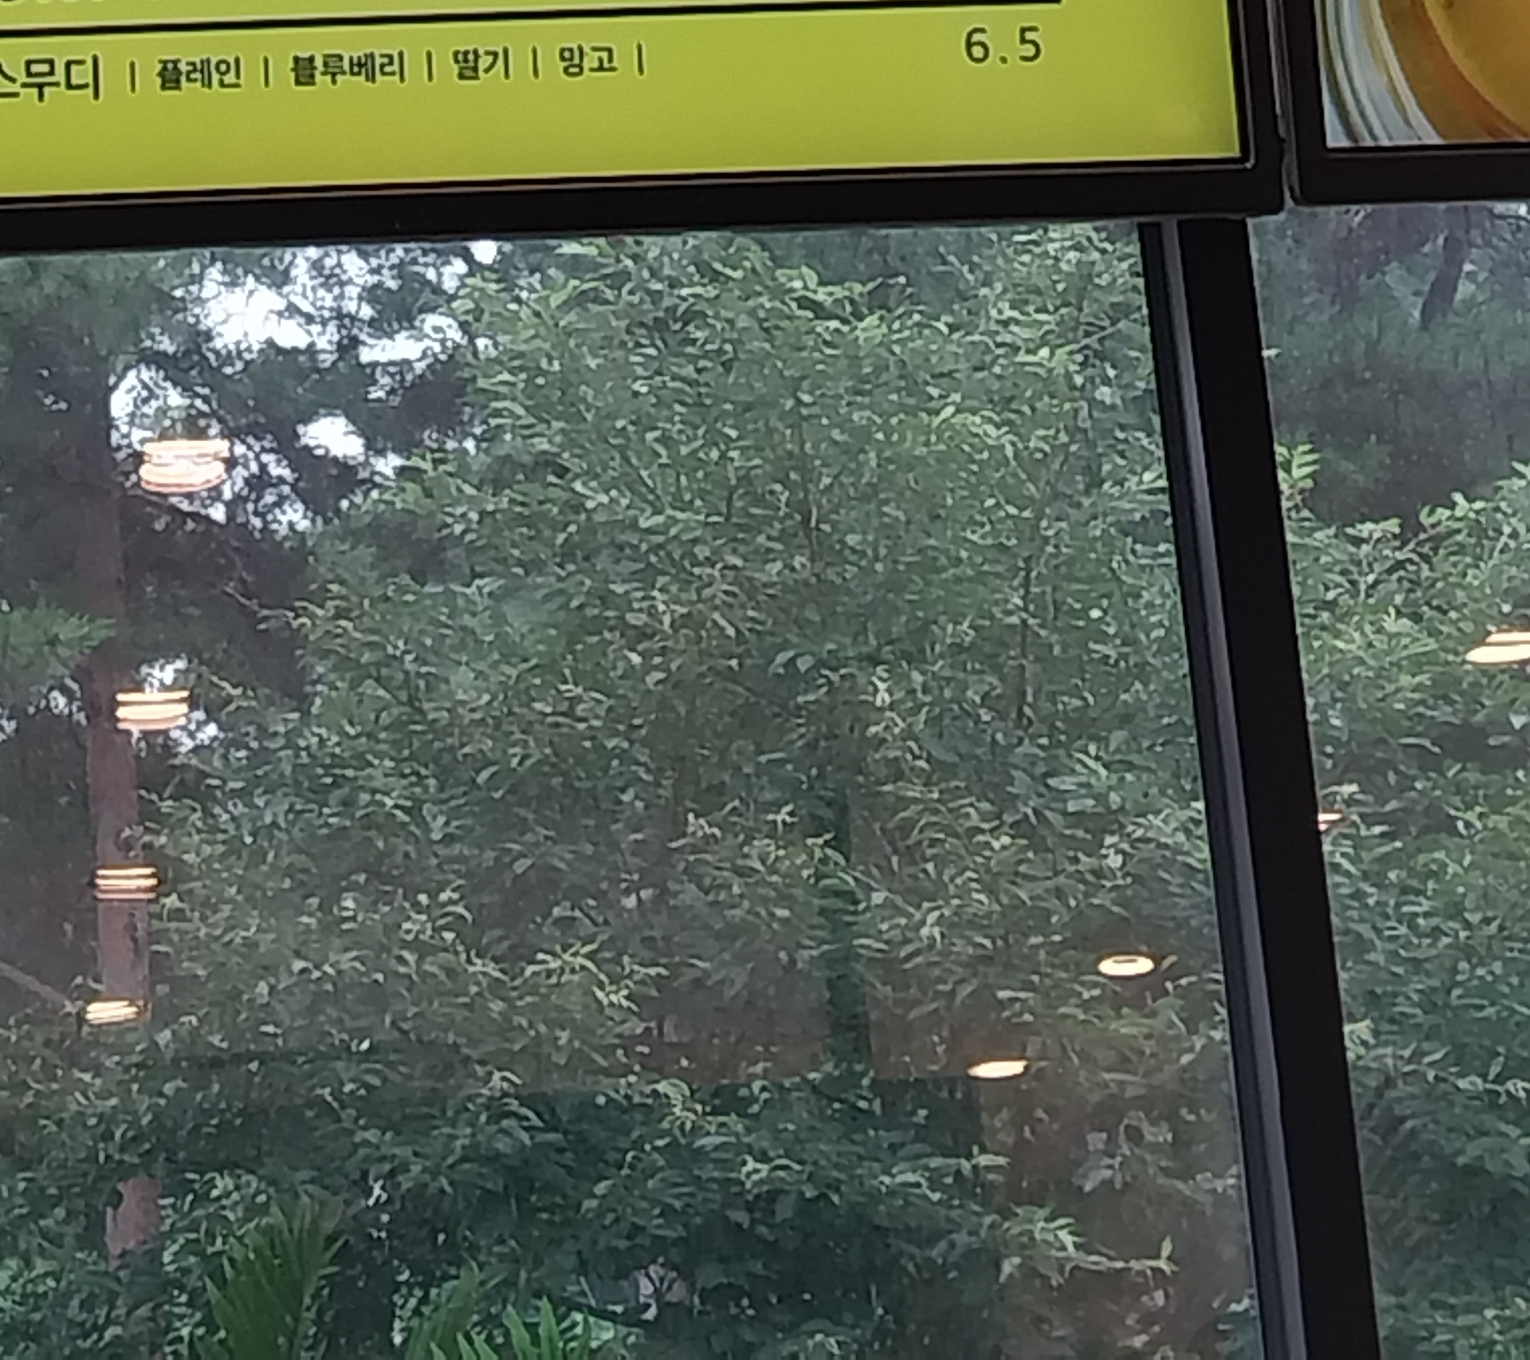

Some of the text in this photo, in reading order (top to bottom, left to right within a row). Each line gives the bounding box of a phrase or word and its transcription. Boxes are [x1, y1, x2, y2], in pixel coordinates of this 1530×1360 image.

[965, 26, 1041, 64] 6.5
[157, 56, 241, 91] 플레인
[291, 50, 405, 86] 블루베리
[453, 47, 509, 80] 딸기
[559, 44, 617, 77] 망고
